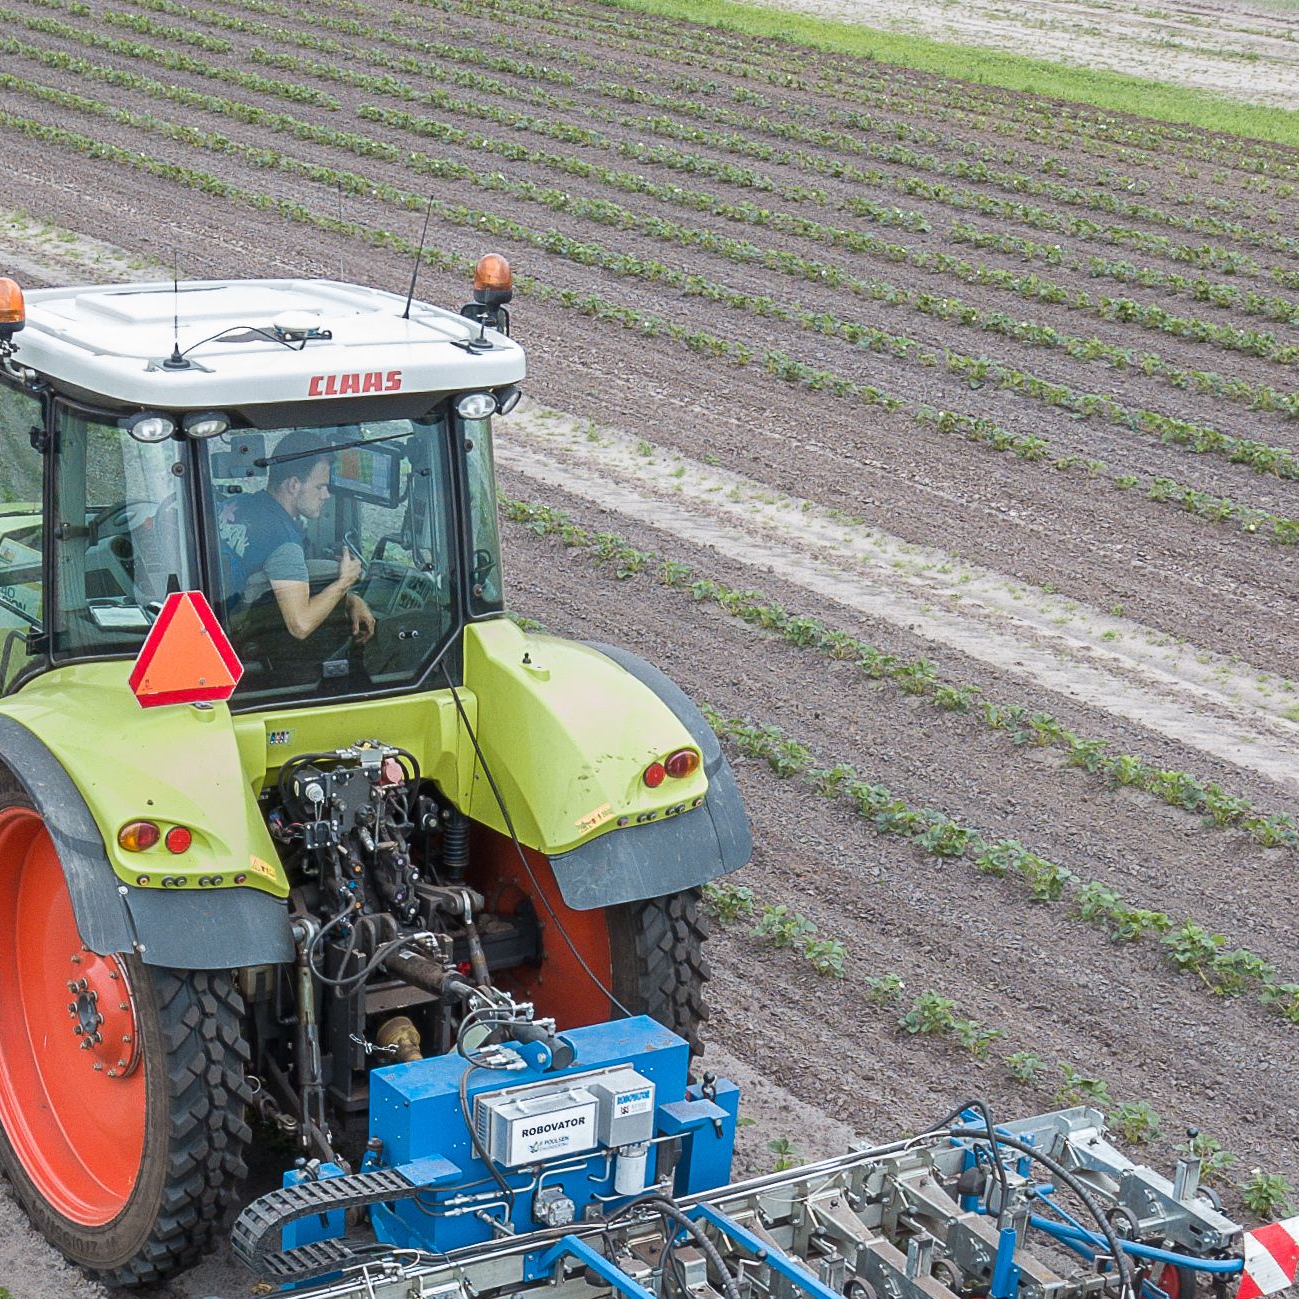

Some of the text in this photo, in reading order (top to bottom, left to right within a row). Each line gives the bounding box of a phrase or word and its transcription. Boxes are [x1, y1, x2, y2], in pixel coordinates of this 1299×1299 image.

[308, 371, 402, 396] CLAAS
[522, 1117, 586, 1137] ROBOVATOR
[544, 1136, 569, 1145] POULSEN
